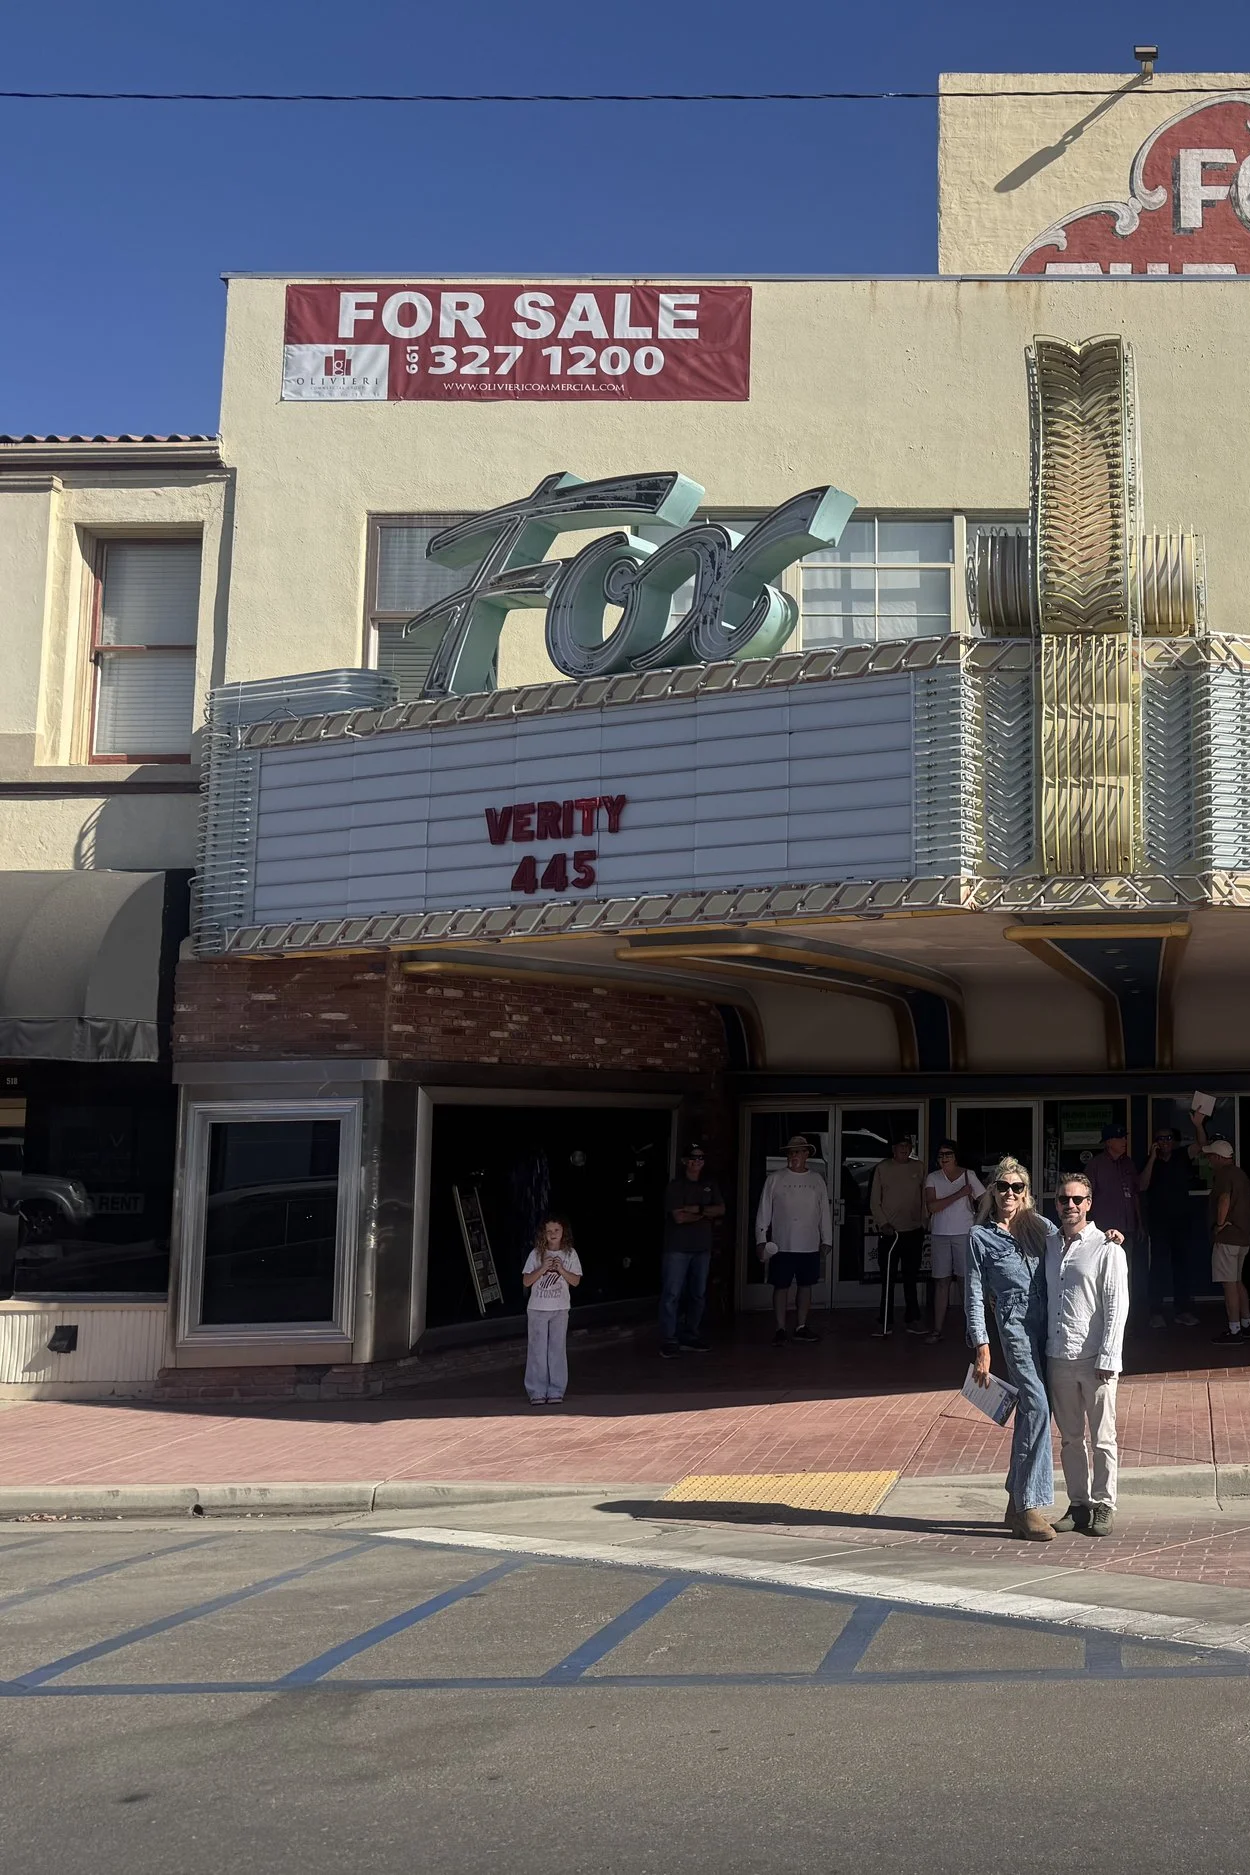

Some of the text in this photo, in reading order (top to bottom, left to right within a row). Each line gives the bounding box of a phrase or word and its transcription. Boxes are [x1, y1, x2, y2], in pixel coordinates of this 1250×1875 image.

[337, 291, 700, 341] FOR SALE
[405, 345, 419, 375] 661
[428, 344, 666, 377] 327 1200
[296, 377, 379, 386] OLIVIERI
[443, 381, 626, 392] WWW.OLIVIERICOMMERCIAL.COM
[402, 471, 858, 699] Fox
[485, 794, 627, 846] VERITY
[511, 849, 597, 894] 445
